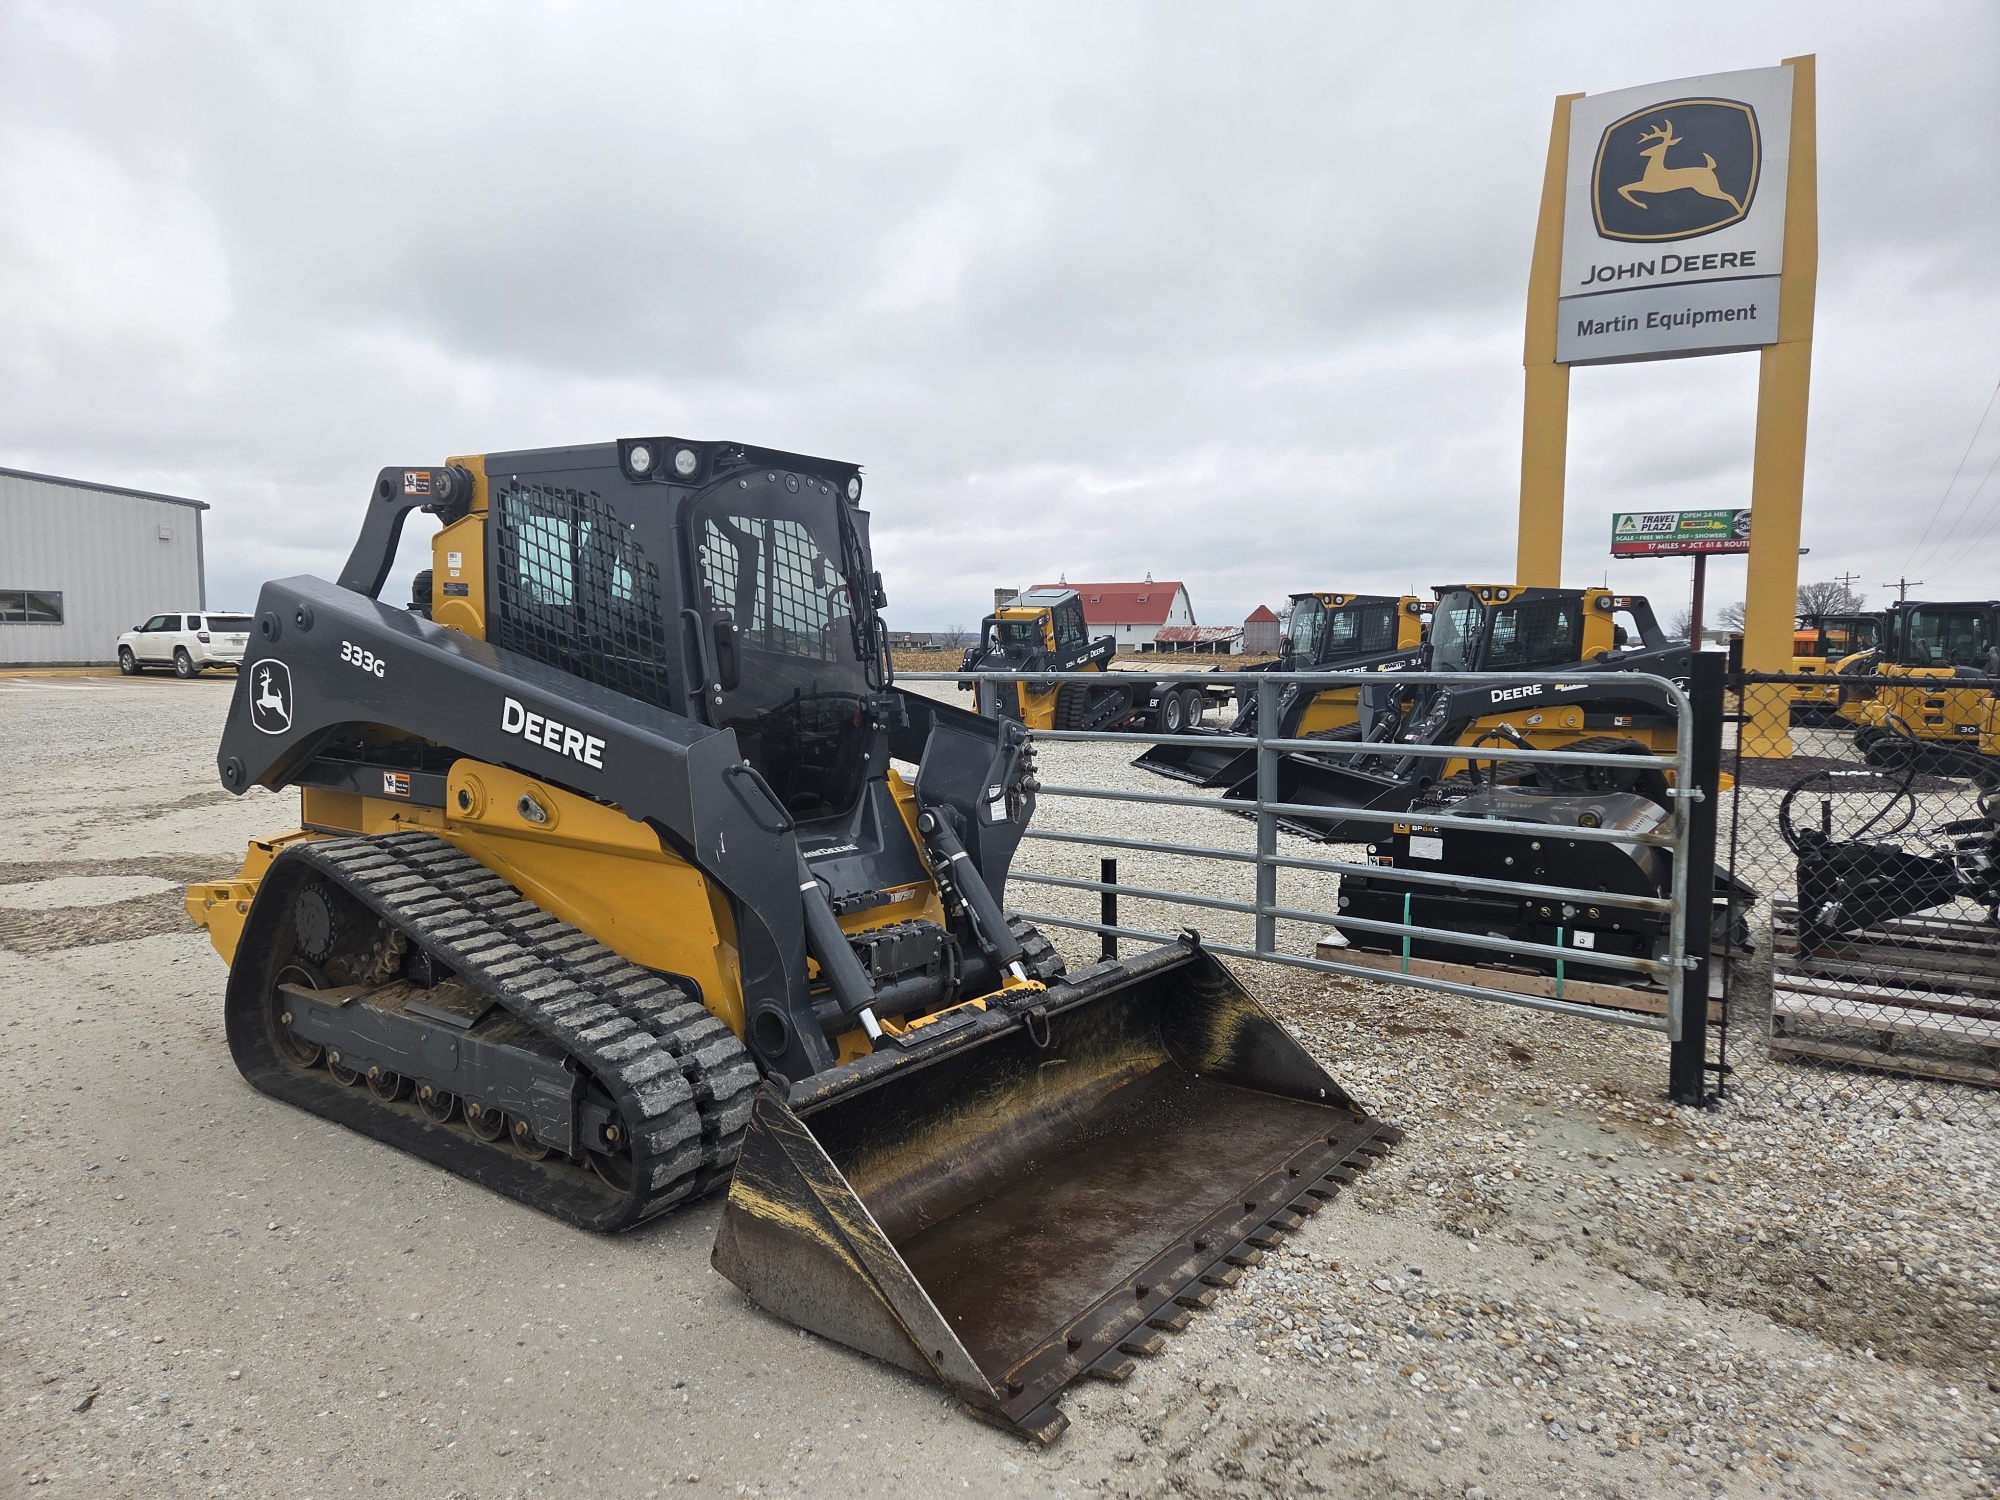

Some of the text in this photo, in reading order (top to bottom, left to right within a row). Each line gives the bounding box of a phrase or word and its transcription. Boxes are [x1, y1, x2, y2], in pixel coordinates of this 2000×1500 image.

[1581, 250, 1756, 285] JOHN DEERE
[1577, 303, 1757, 337] Martin Equipment
[1641, 523, 1672, 531] PLAZA
[1642, 515, 1675, 524] TRAVEL
[340, 640, 386, 678] 333G
[1091, 646, 1105, 657] DEERE
[1491, 684, 1542, 702] DEERE
[501, 696, 606, 770] DEERE
